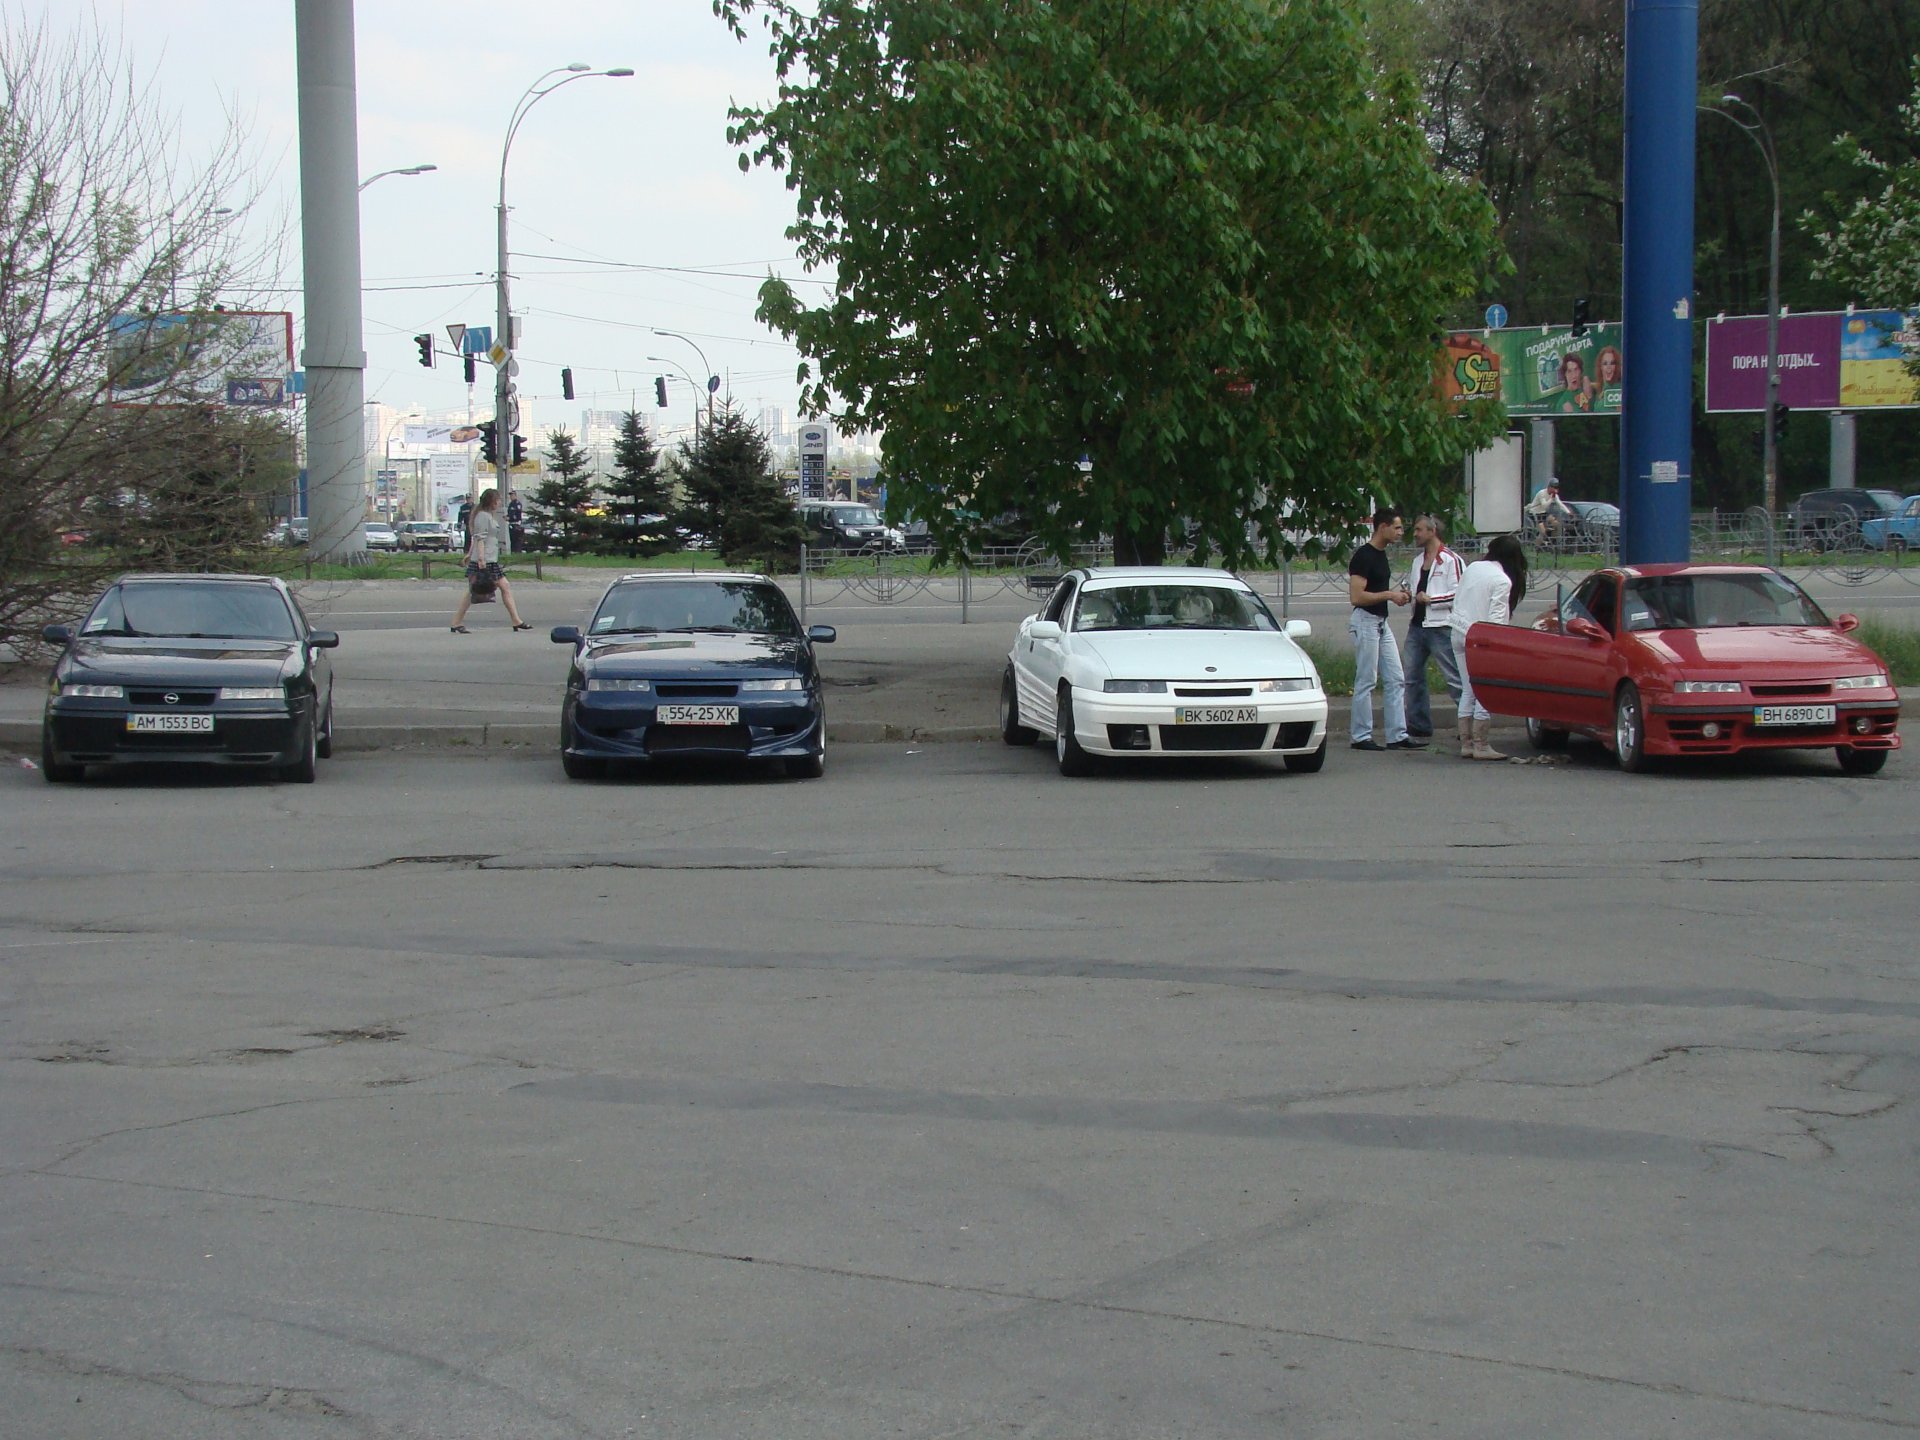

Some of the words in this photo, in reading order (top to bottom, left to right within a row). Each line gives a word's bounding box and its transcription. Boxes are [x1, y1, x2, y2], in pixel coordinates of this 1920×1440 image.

[1526, 328, 1591, 357] ПОДАРУНКА
[1566, 338, 1594, 353] КАРТА
[1732, 355, 1759, 369] ПОРА
[669, 707, 714, 720] 554-25
[716, 707, 735, 720] XK
[1185, 710, 1202, 722] BK
[1206, 710, 1234, 722] 5602
[1237, 709, 1253, 722] AX
[1763, 709, 1781, 721] BH
[1785, 708, 1813, 720] 6890
[136, 716, 155, 729] AM
[159, 716, 188, 729] 1553
[191, 717, 210, 729] BC
